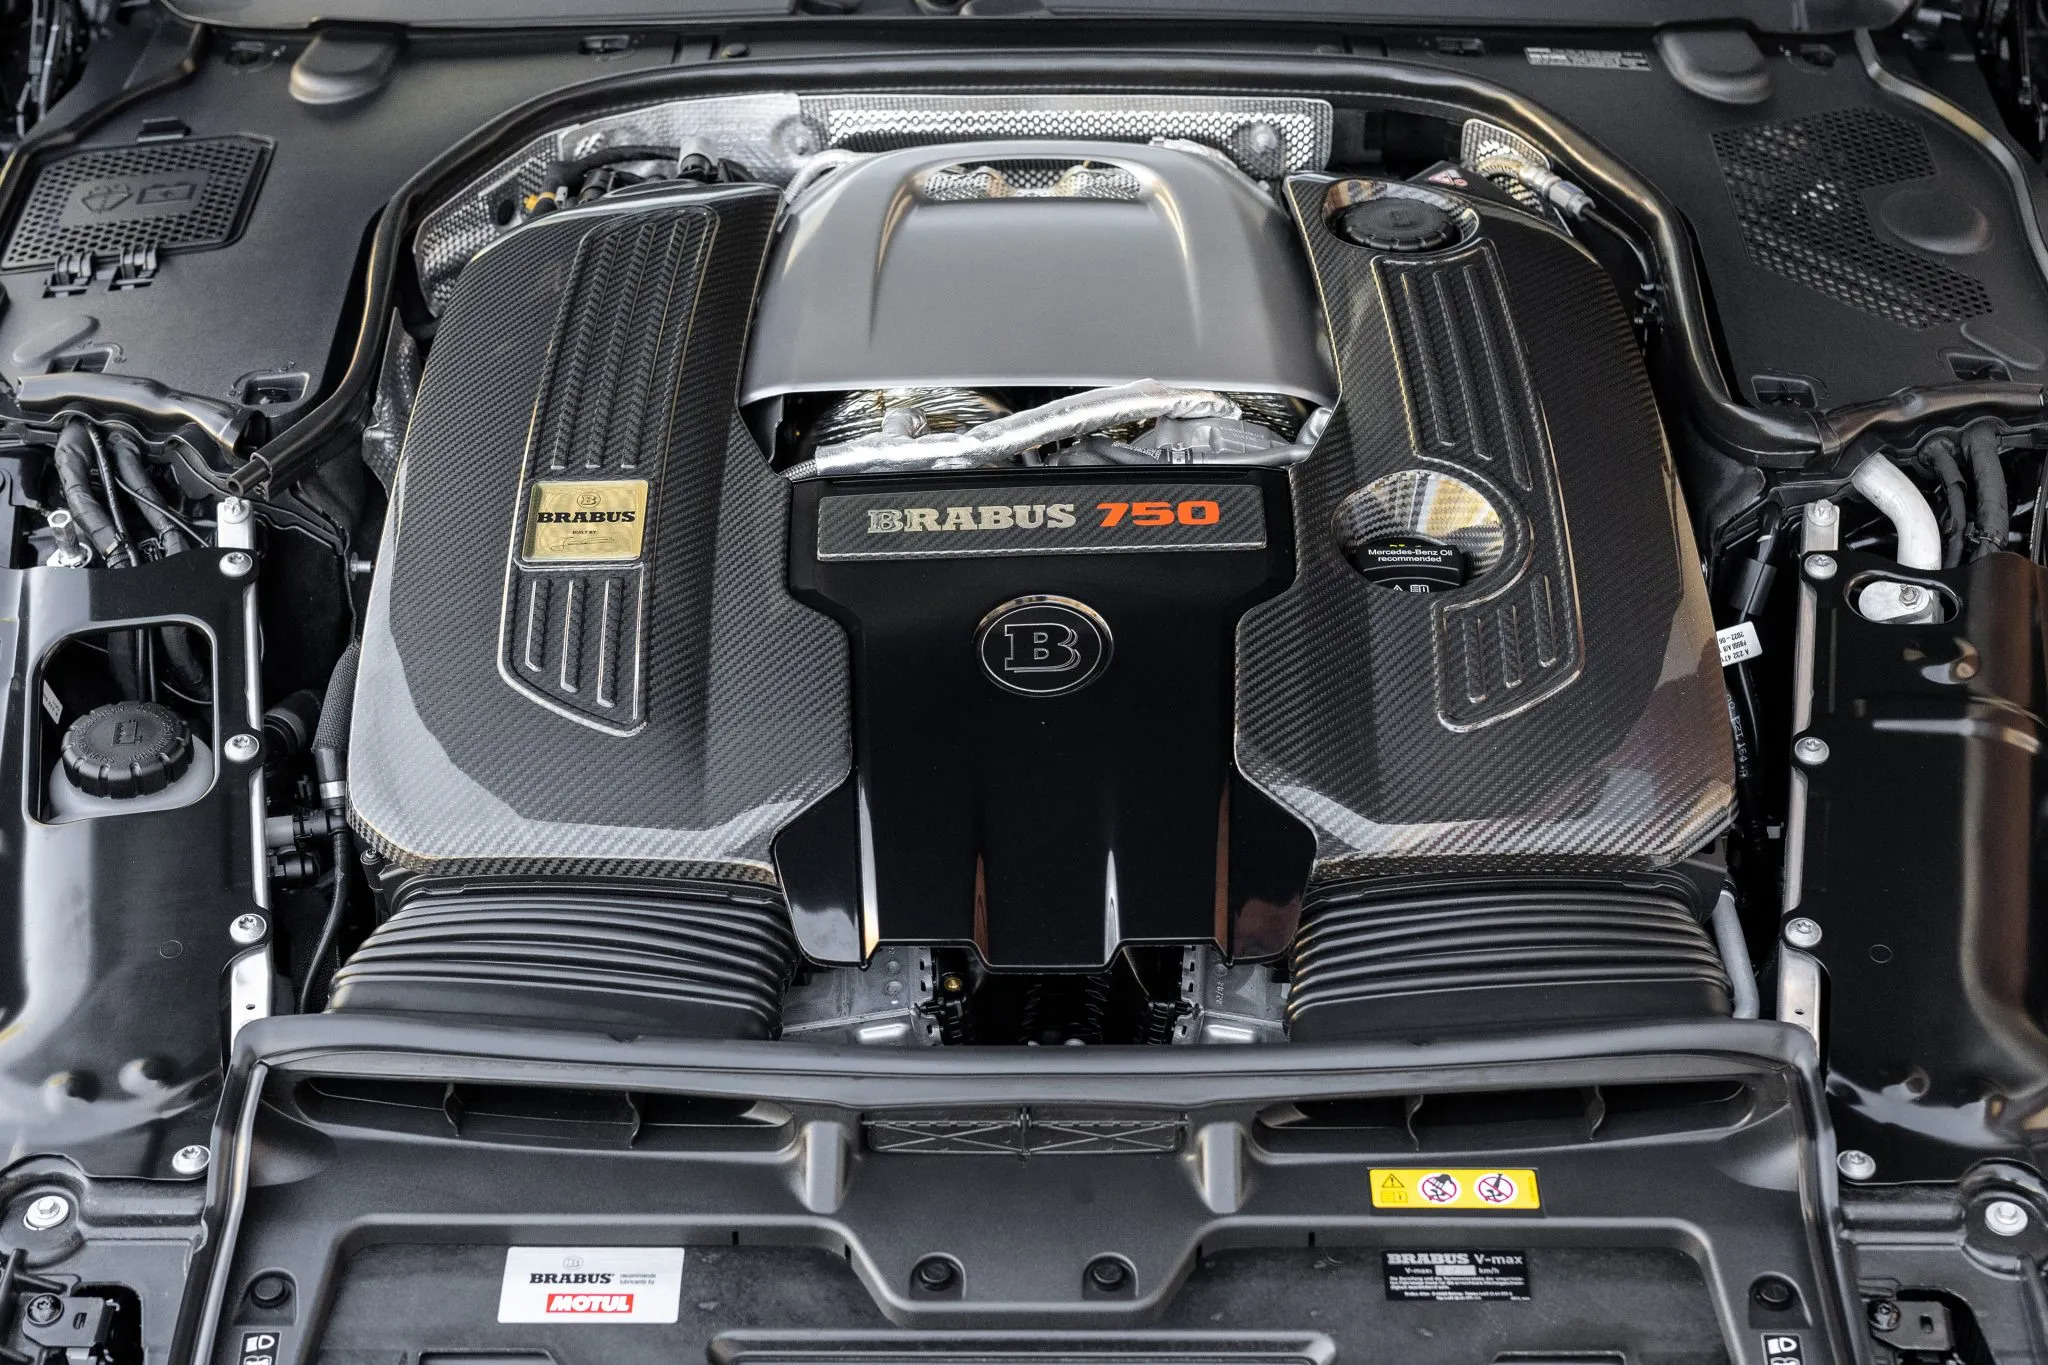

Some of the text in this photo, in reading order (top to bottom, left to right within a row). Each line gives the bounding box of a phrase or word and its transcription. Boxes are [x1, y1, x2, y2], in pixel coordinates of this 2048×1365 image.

[537, 511, 635, 523] BRABUS
[868, 500, 1220, 533] BRABUS 750
[1004, 623, 1081, 673] B
[1387, 1253, 1523, 1264] BRABUS V-max
[1479, 1267, 1500, 1275] km/h
[530, 1273, 612, 1284] BRABUS
[549, 1295, 630, 1312] MOTUL
